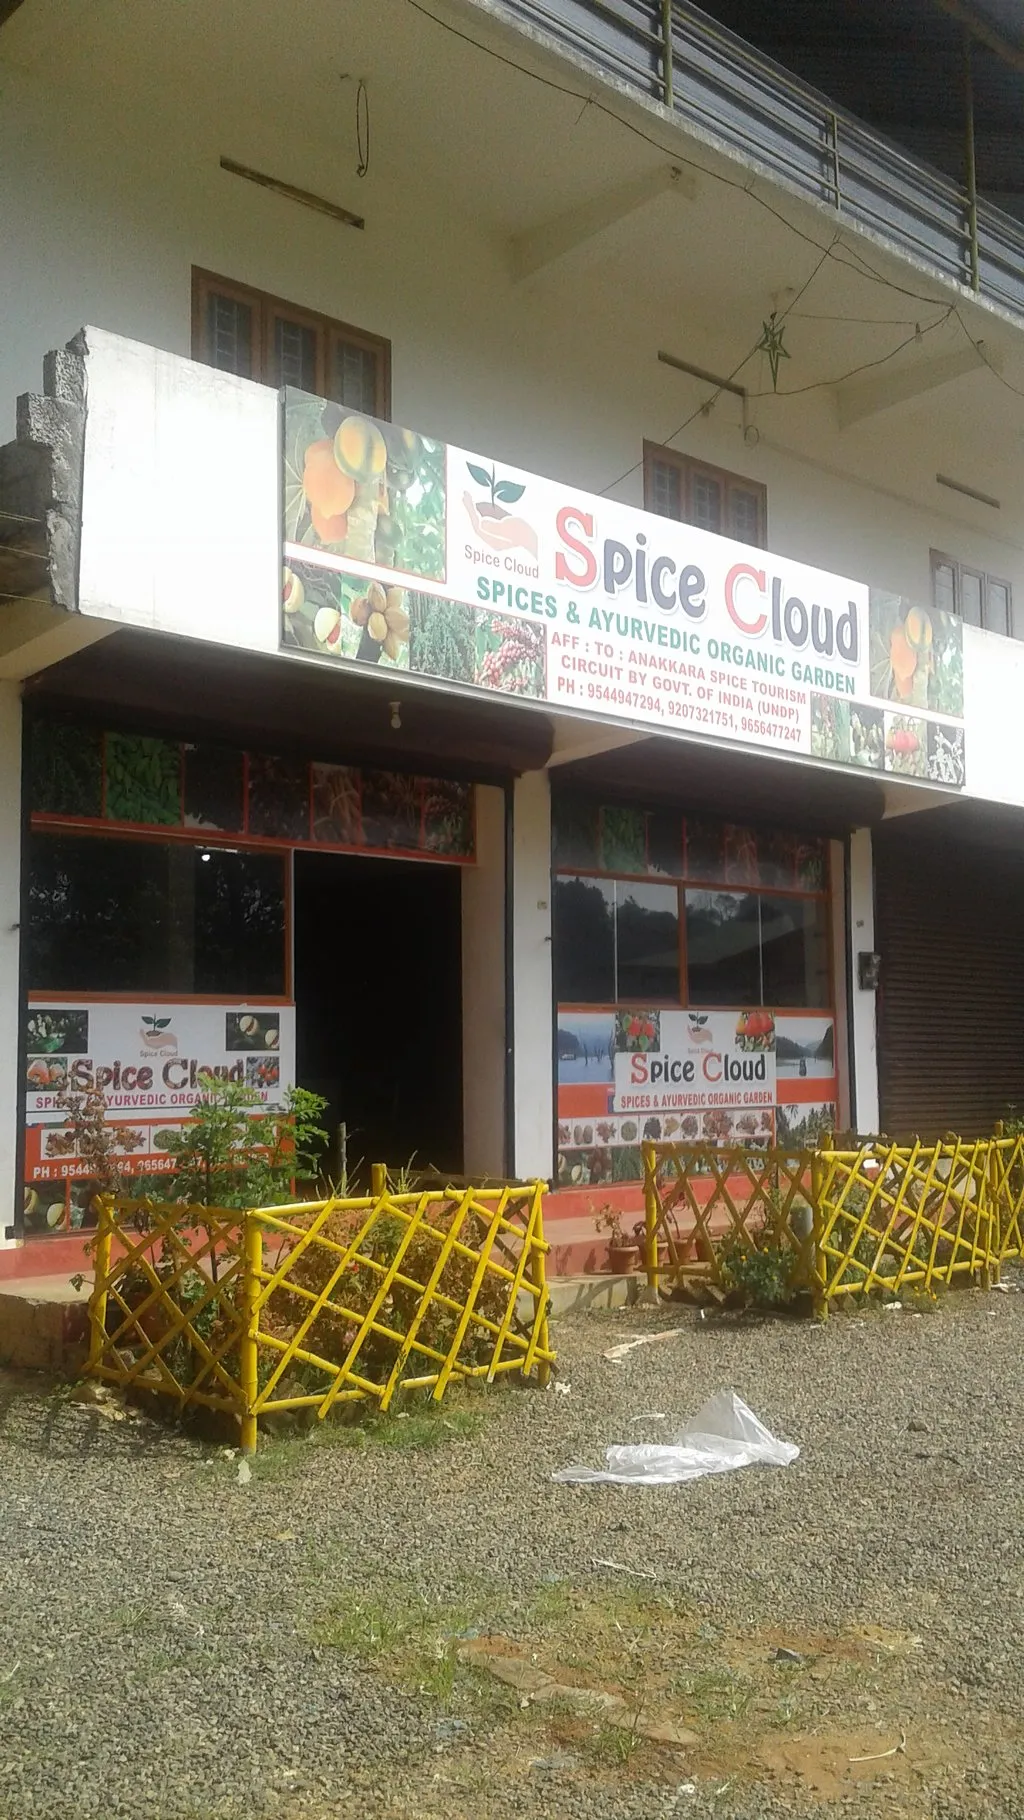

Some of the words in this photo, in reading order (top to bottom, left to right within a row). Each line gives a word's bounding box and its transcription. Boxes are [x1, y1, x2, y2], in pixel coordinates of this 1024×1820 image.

[465, 544, 500, 567] Spice
[504, 557, 539, 579] Cloud
[555, 506, 706, 618] Spice
[724, 563, 858, 662] Cloud
[476, 576, 557, 618] SPICES
[566, 601, 580, 624] &
[589, 607, 700, 655] AYURVEDIC
[707, 639, 785, 677] ORGANIC
[792, 661, 855, 695] GARDEN
[551, 632, 579, 649] AFF
[594, 641, 614, 658] TO
[628, 650, 705, 680] ANAKKARA
[710, 670, 747, 690] SPICE
[752, 680, 806, 704] TOURISM
[561, 655, 623, 680] CIRCUIT
[628, 672, 647, 686] BY
[653, 676, 692, 697] GOVT.
[697, 686, 714, 701] OF
[719, 691, 753, 711] INDIA
[757, 702, 799, 723] (UNDP)
[557, 676, 575, 694] PH
[588, 682, 664, 717] 9544947294,
[668, 700, 737, 732] 9207321751,
[741, 717, 801, 743] 9656477247
[71, 1059, 153, 1091] Spice
[630, 1052, 694, 1084] Spice
[702, 1052, 766, 1082] Cloud
[98, 1094, 166, 1107] YURVEDIC
[621, 1095, 650, 1108] SPICES
[653, 1095, 659, 1106] &
[661, 1093, 706, 1107] AYURVEDIC
[708, 1092, 742, 1105] ORGANIC
[743, 1091, 772, 1104] GARDEN
[33, 1166, 50, 1178] PH
